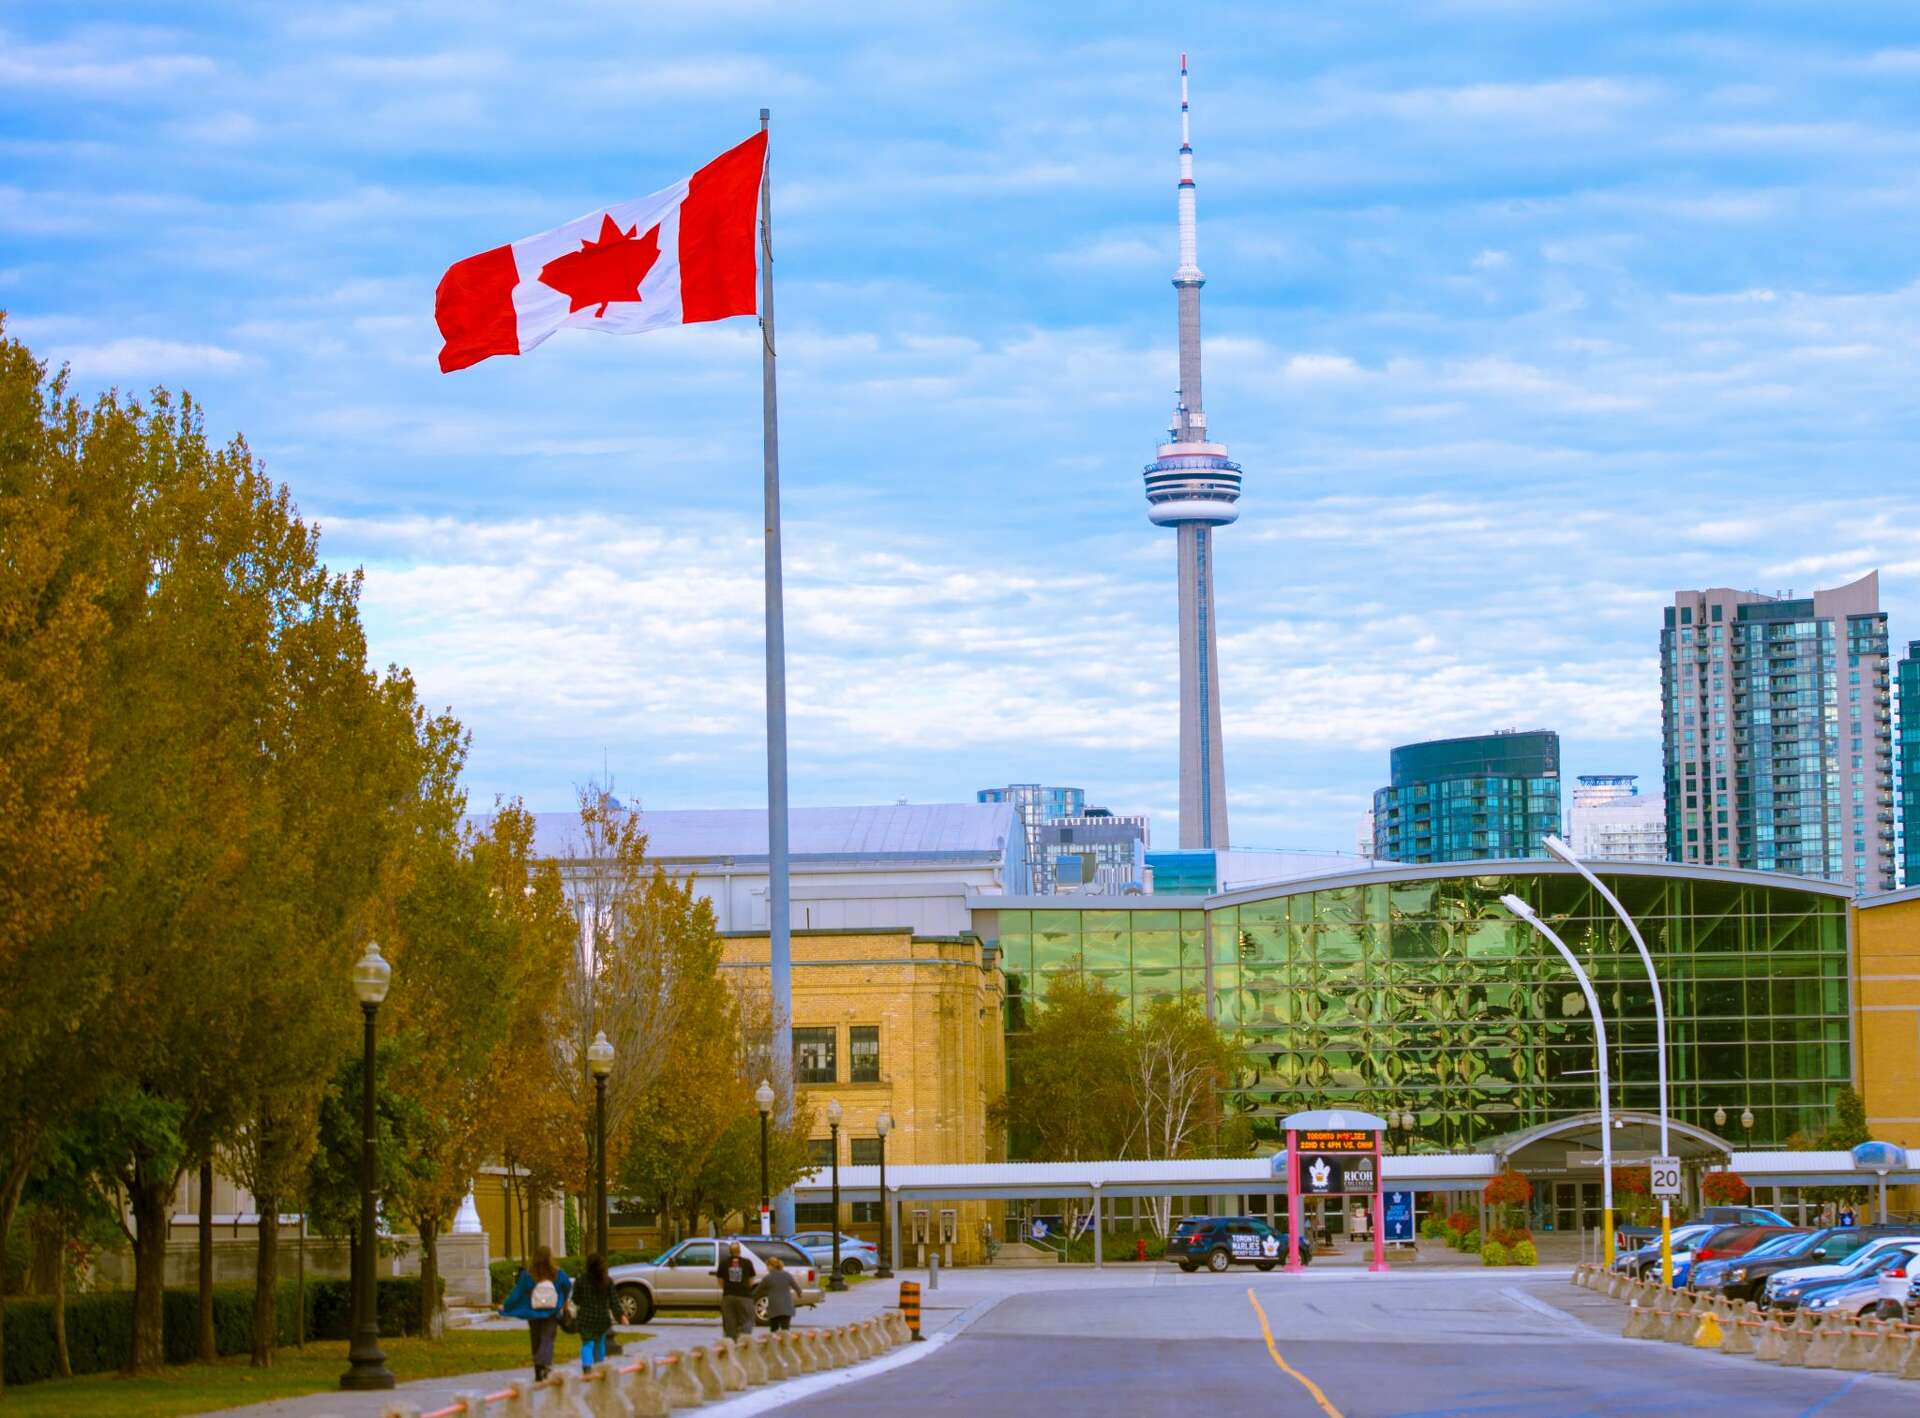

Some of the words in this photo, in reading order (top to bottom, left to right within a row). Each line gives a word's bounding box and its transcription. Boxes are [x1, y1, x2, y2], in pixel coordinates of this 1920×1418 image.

[1343, 1171, 1373, 1181] RICOH
[1654, 1170, 1678, 1187] 20
[1232, 1234, 1260, 1242] TORONTO
[1232, 1242, 1260, 1250] MARLIES
